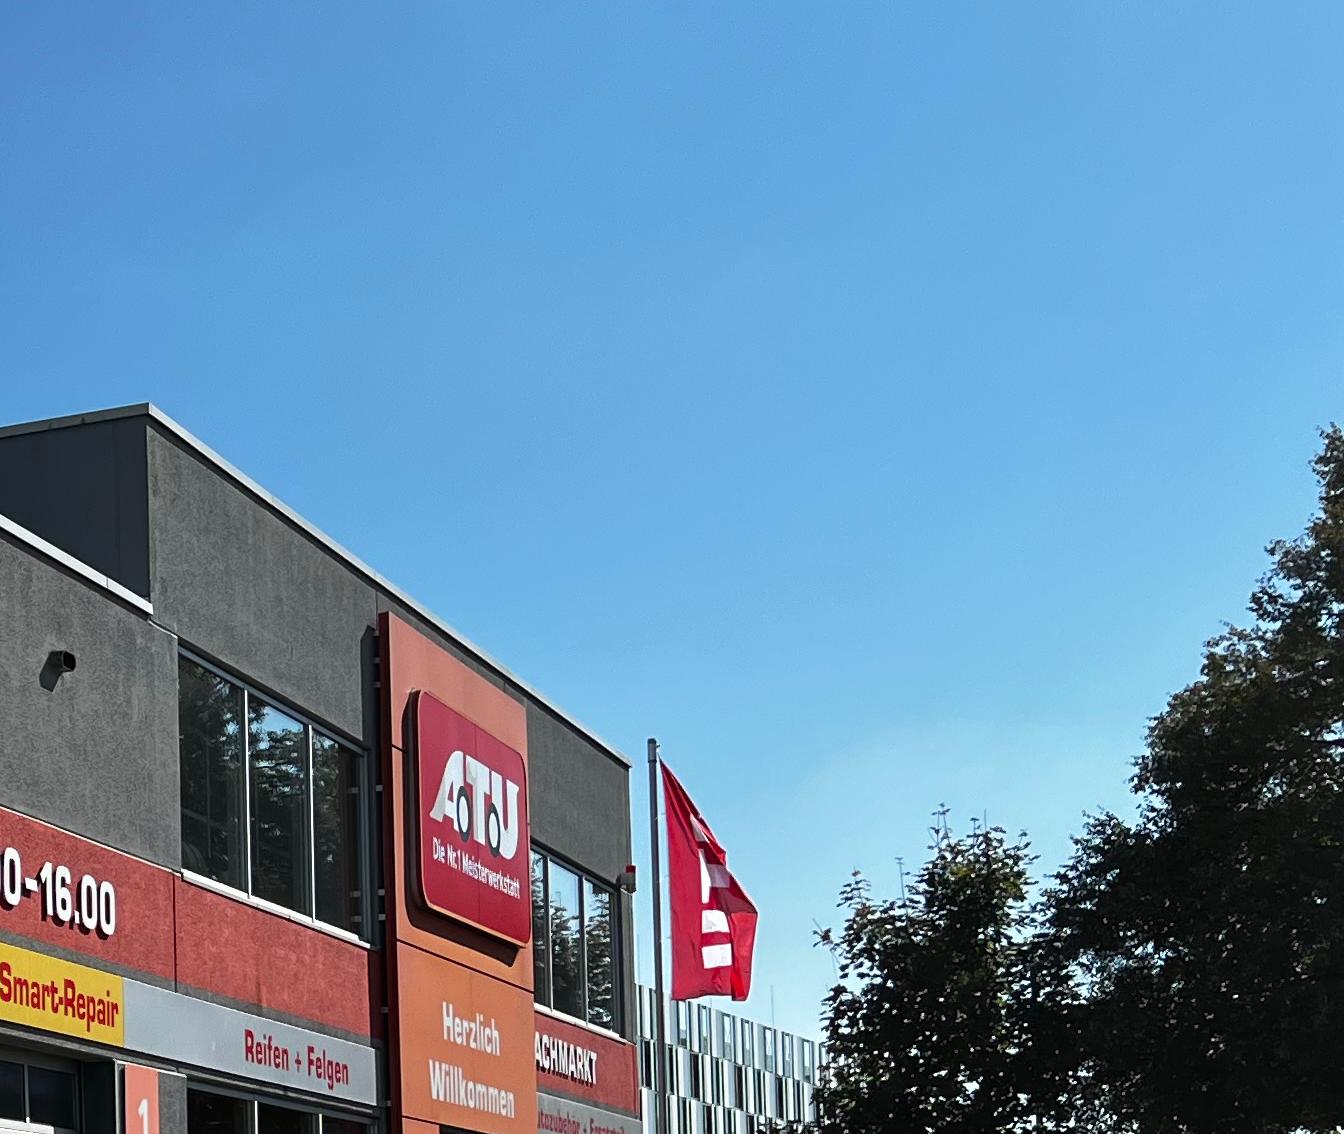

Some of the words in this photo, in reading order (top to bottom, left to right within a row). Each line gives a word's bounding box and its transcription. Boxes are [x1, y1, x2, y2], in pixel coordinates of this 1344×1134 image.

[432, 837, 445, 863] Die
[462, 854, 520, 899] Meisterwerkstatt
[0, 961, 119, 1032] Smart-Repair
[442, 1001, 500, 1056] Herzlich
[244, 1029, 289, 1071] Reifen
[307, 1046, 349, 1090] Felgen
[429, 1059, 515, 1118] Willkommen
